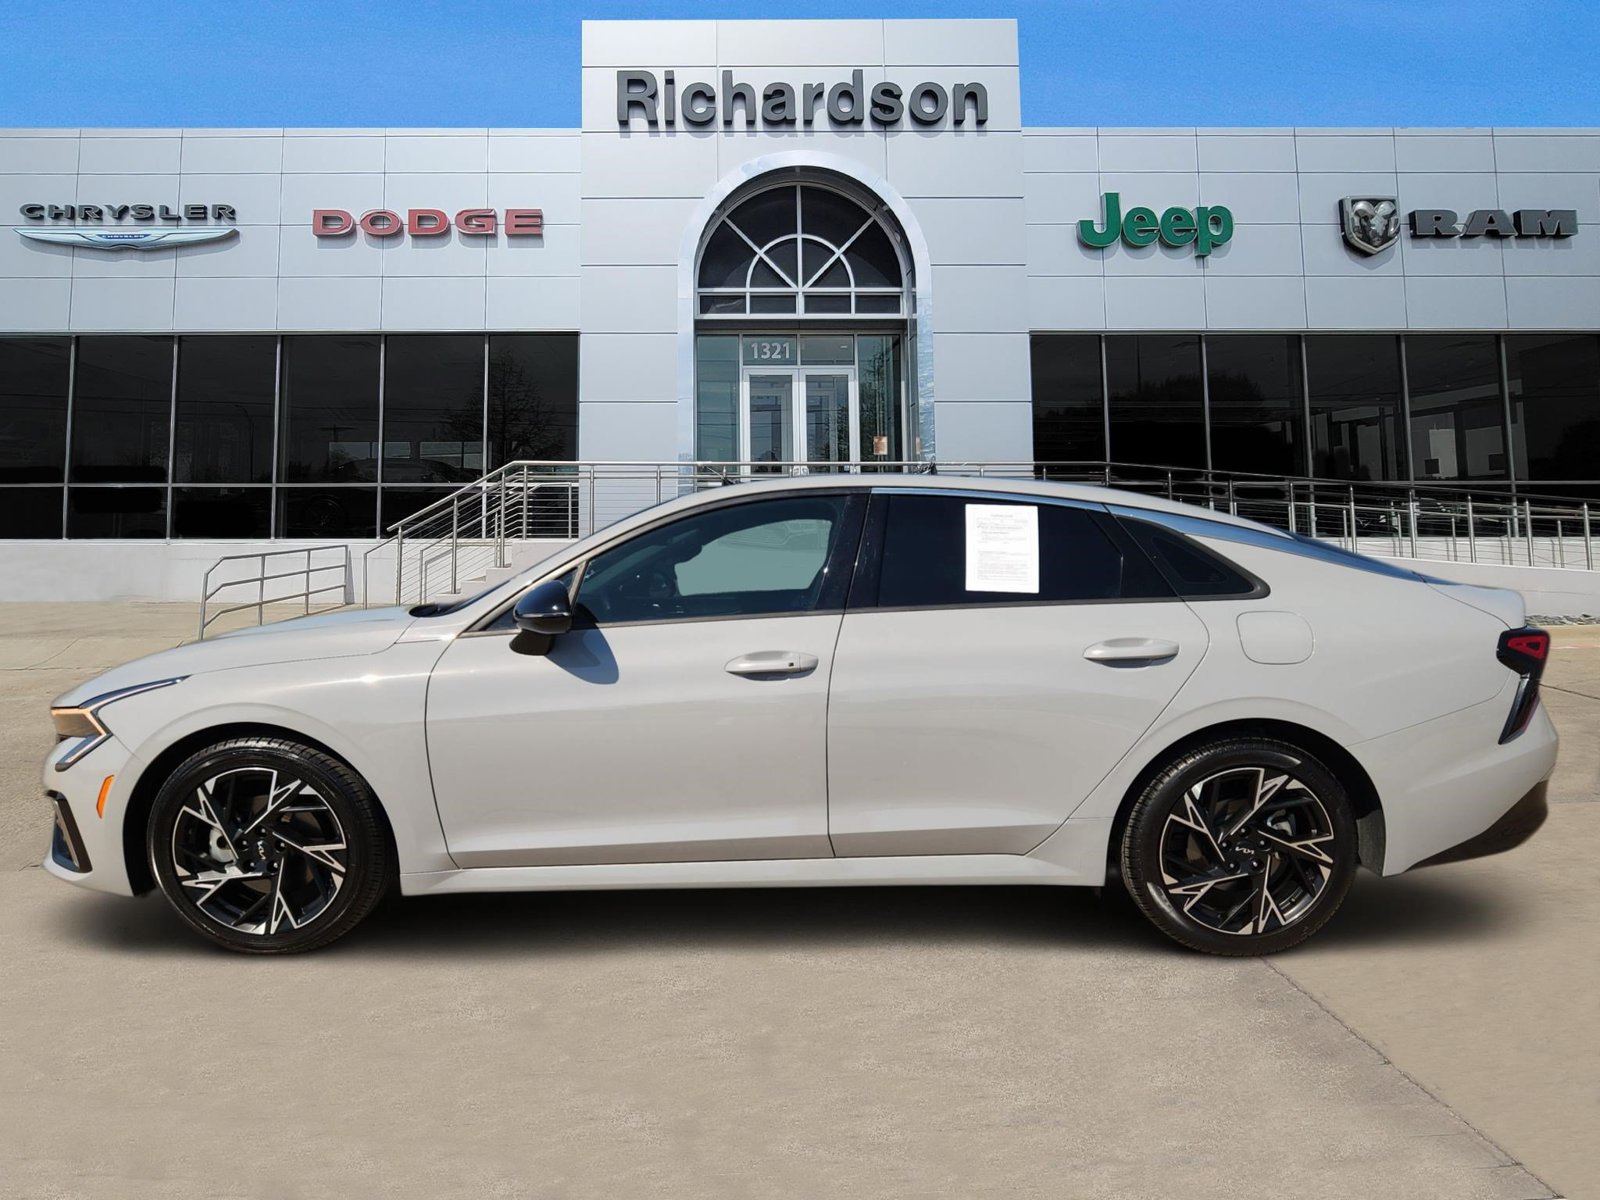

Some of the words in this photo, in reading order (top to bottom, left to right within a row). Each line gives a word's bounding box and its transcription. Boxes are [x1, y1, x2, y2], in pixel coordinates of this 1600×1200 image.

[616, 69, 988, 126] Richardson
[19, 203, 236, 221] CHRYSLER
[312, 208, 544, 236] DODGE
[1076, 192, 1234, 257] Jeep
[1408, 209, 1578, 239] RAM
[751, 342, 790, 359] 1321
